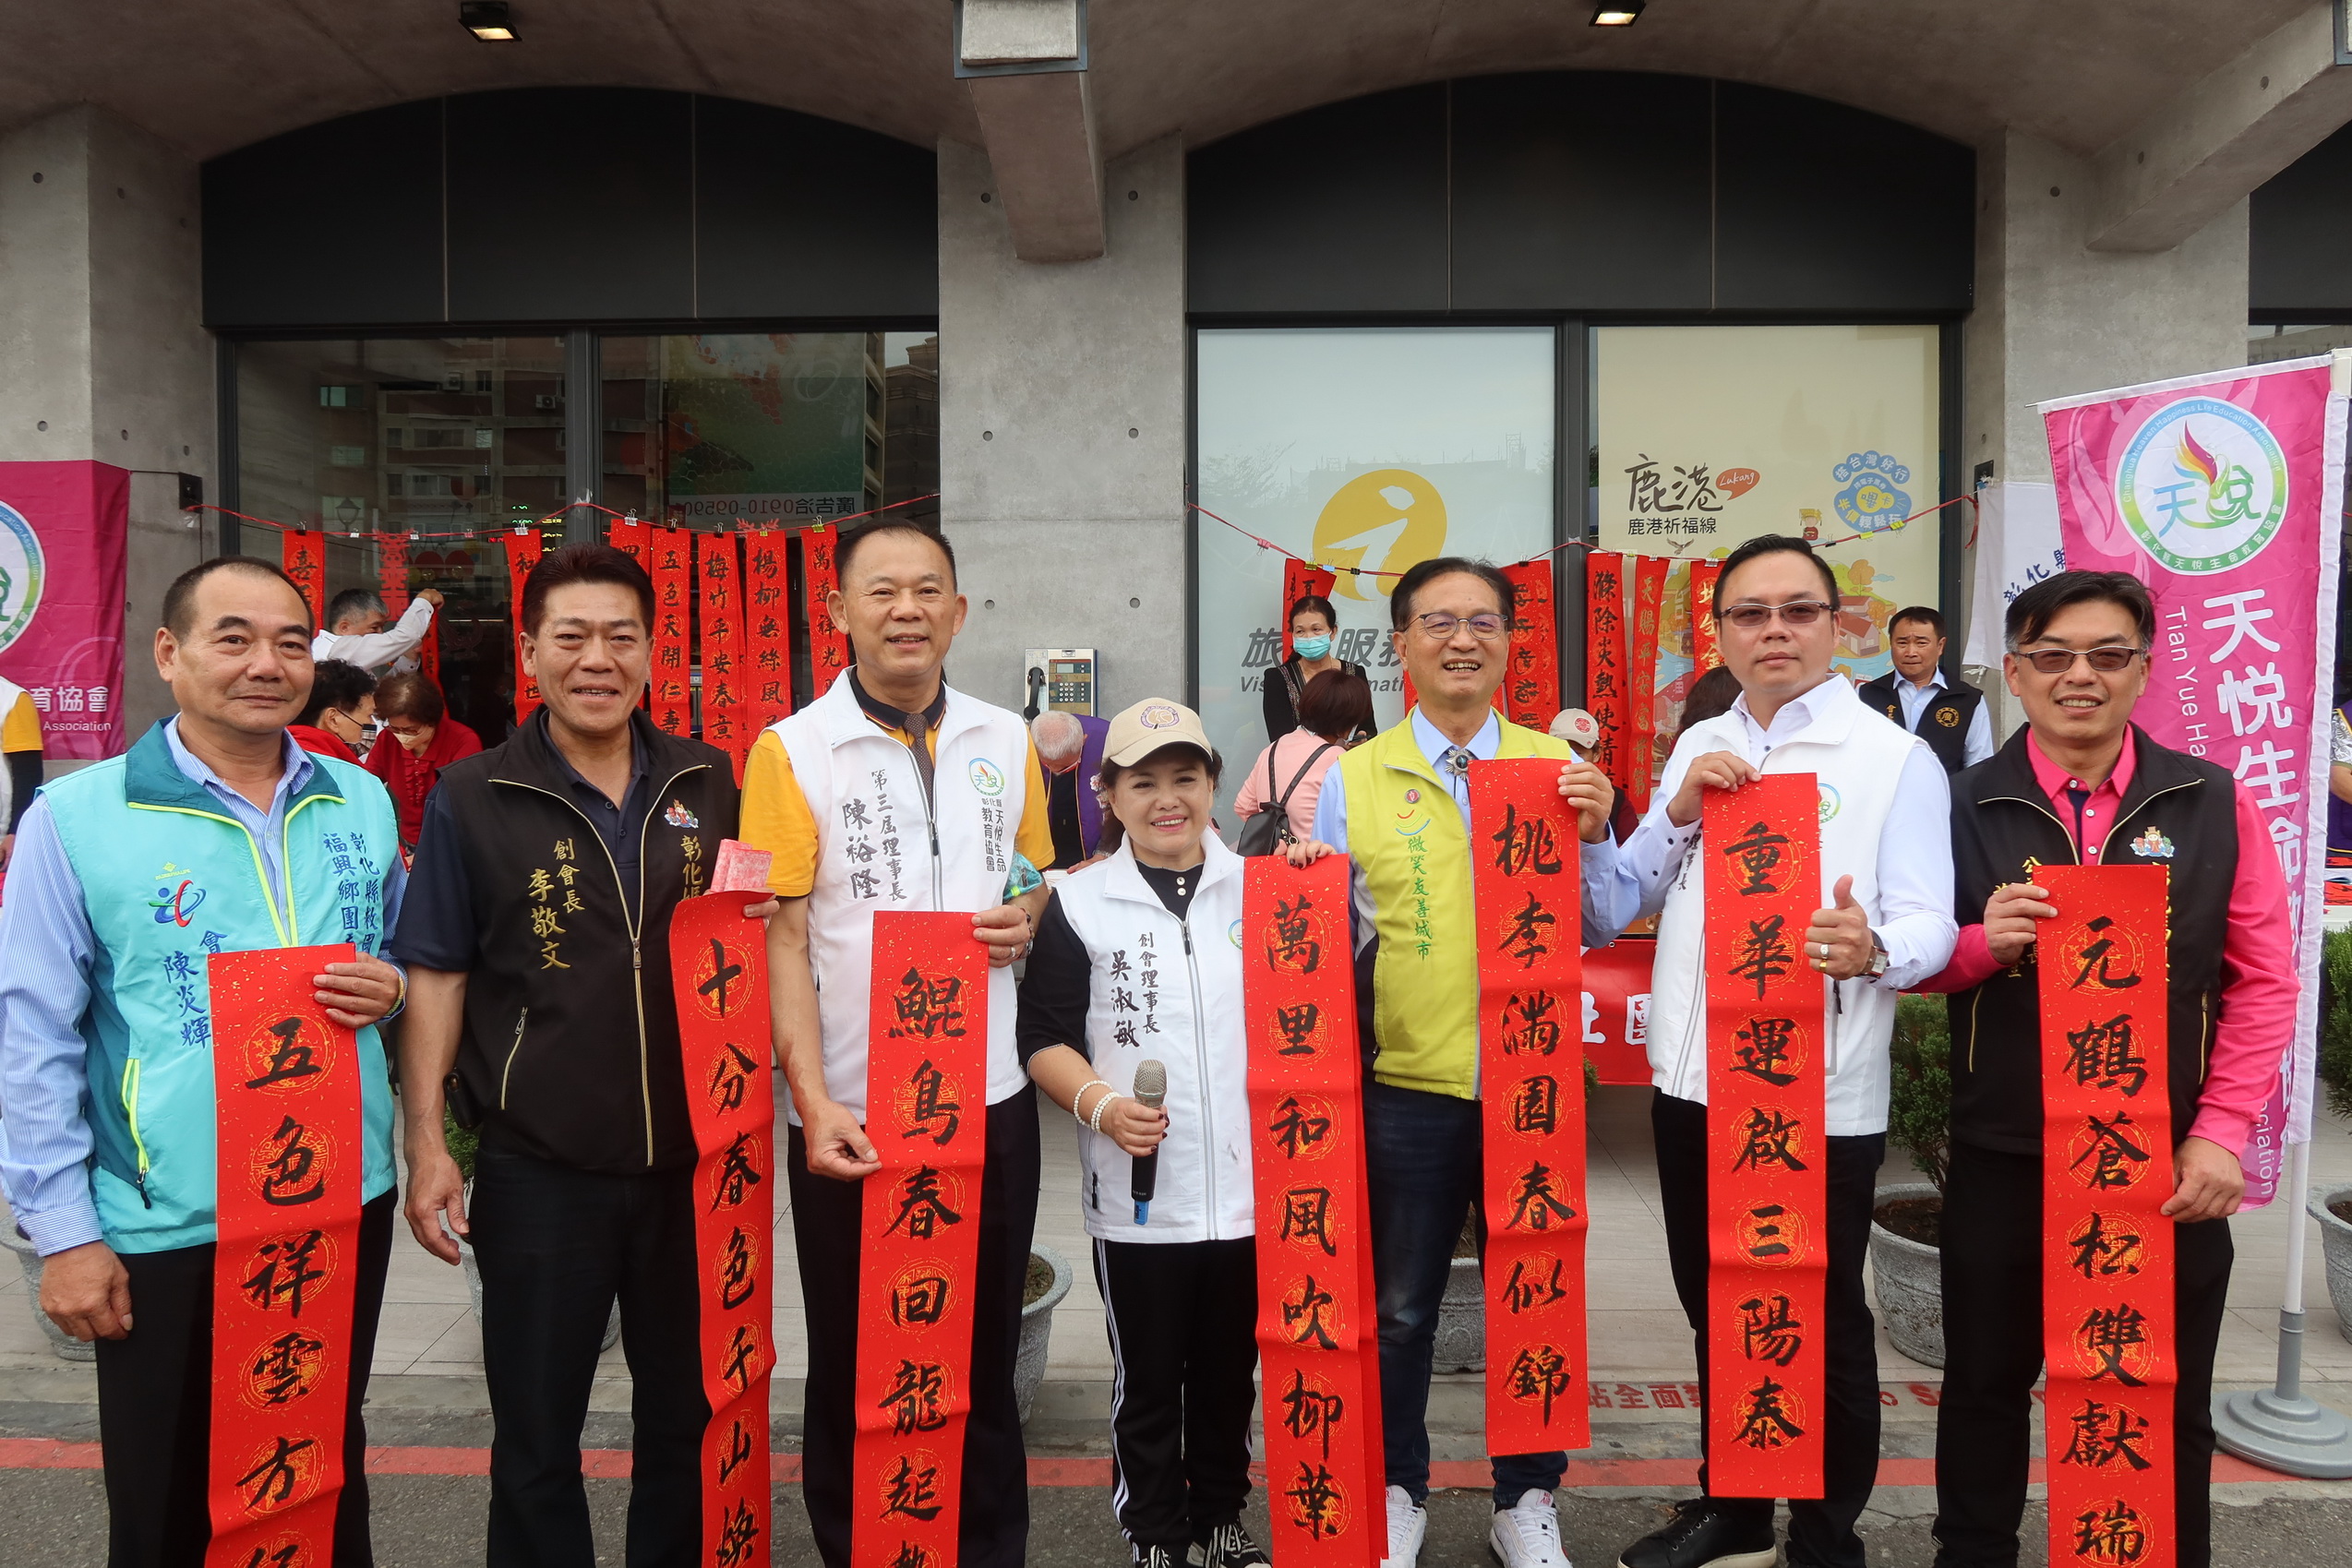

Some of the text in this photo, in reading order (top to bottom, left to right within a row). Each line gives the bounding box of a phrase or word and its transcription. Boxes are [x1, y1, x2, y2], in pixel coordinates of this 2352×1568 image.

[1625, 453, 1723, 513] 鹿港
[1627, 517, 1717, 535] 鹿港祈福線
[2166, 605, 2189, 662] Tian
[43, 720, 112, 732] Association
[2176, 666, 2199, 717] Yue
[554, 837, 585, 914] 創會長
[842, 798, 882, 901] 陳裕隆
[871, 768, 907, 902] 第三屆理事長
[981, 807, 995, 872] 教育協會
[994, 808, 1007, 873] 天悅生命
[528, 868, 571, 969] 李敬文
[1408, 834, 1433, 961] 微笑友善城市
[163, 951, 212, 1049] 陳炎輝
[1110, 950, 1140, 1048] 吳淑敏
[1138, 931, 1161, 1035] 創會理事長
[1493, 803, 1578, 1429] 桃李滿園春似錦
